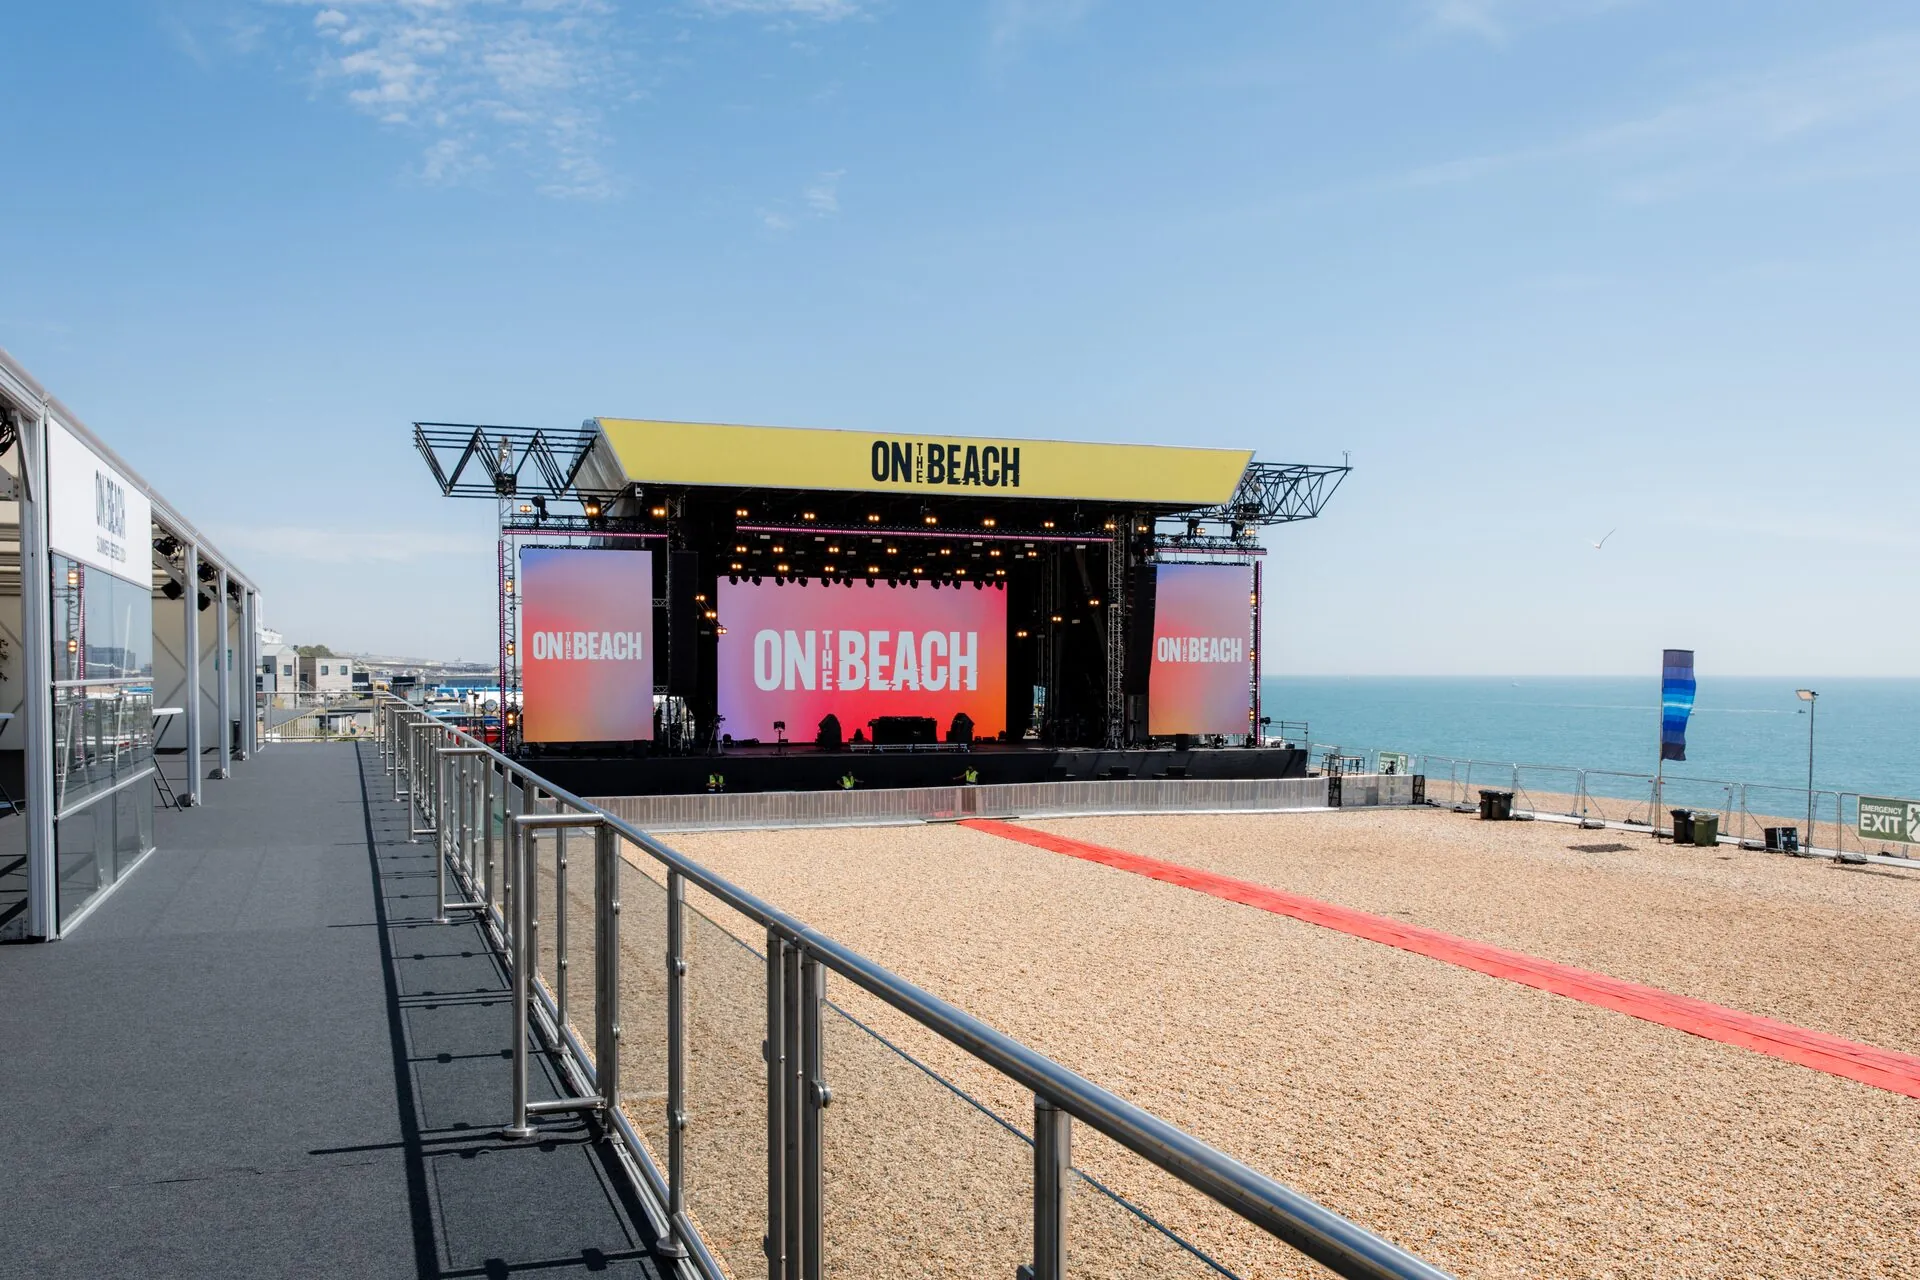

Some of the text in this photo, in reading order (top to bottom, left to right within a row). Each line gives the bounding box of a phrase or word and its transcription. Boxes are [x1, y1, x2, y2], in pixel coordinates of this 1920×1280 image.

[871, 440, 912, 483] ON
[926, 443, 1020, 487] BEACH
[532, 630, 563, 660] ON
[573, 631, 642, 660] BEACH
[1157, 637, 1180, 662] ON
[1188, 637, 1242, 662] BEACH
[753, 629, 978, 691] ON THE BEACH
[1861, 804, 1902, 815] EMERGENCY
[1861, 813, 1902, 834] EXIT
